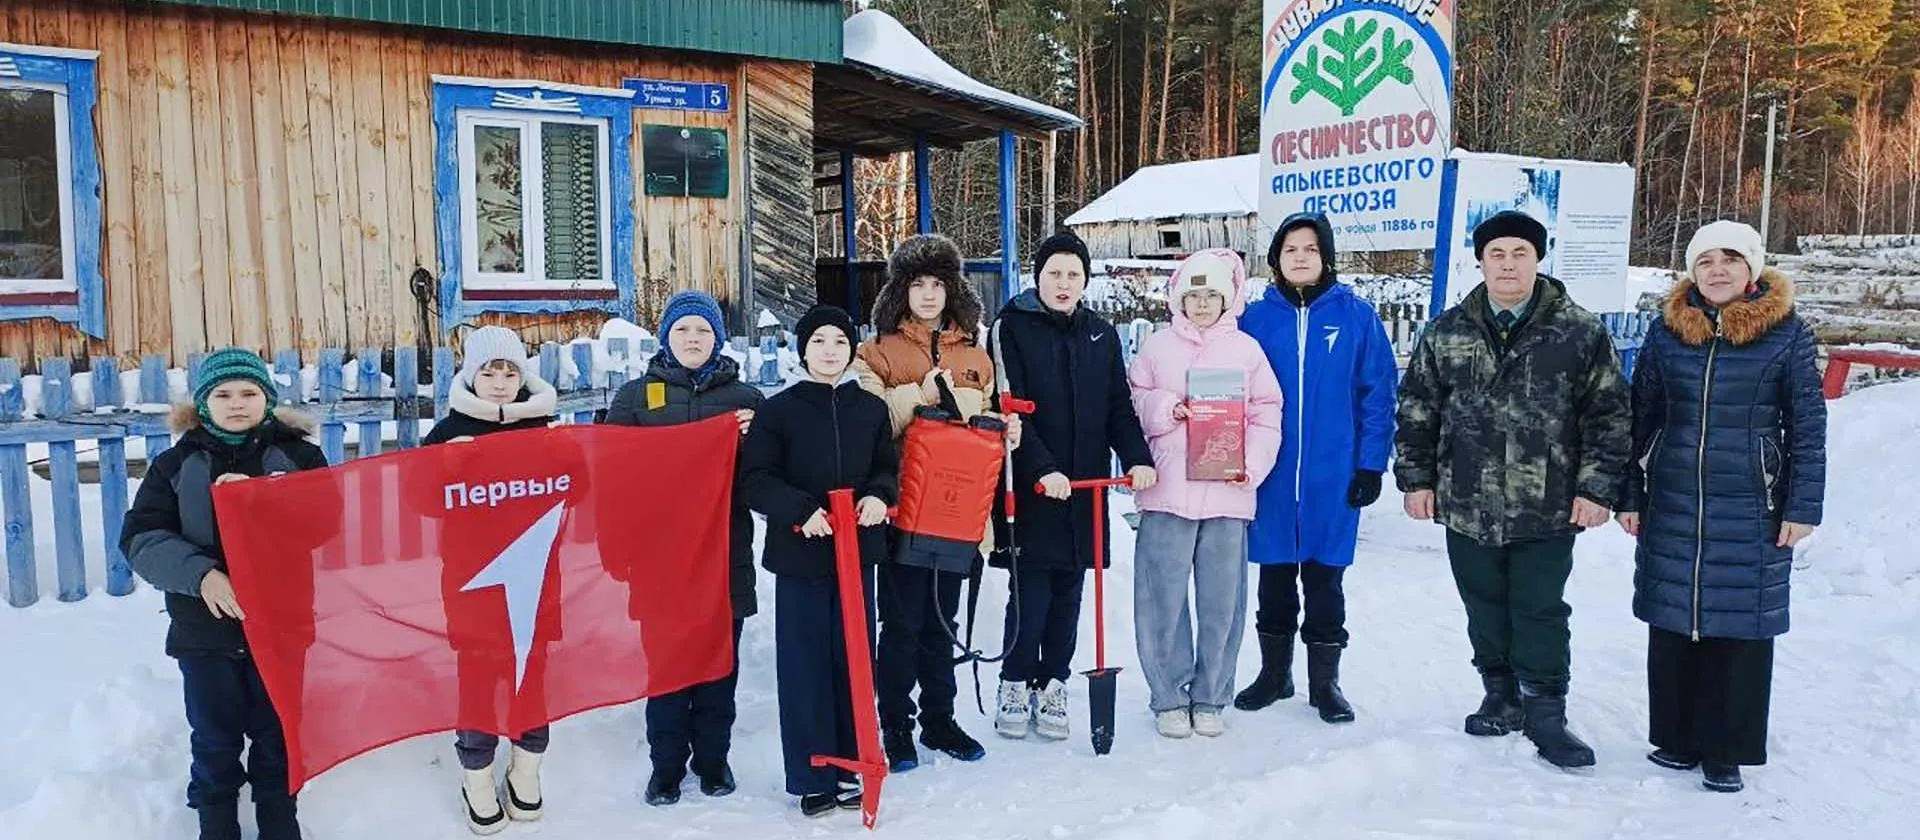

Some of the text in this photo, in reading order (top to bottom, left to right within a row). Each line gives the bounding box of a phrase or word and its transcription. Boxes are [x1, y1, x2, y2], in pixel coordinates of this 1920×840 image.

[710, 90, 721, 106] 5
[1271, 109, 1437, 166] ЛЕСНИЧЕСТВО
[1271, 156, 1435, 195] АЛЬКЕЕВСКОГО
[1303, 188, 1397, 215] ЛЕСХОЗА
[1381, 218, 1417, 233] 11886
[1420, 219, 1435, 231] га
[444, 474, 571, 510] Первые
